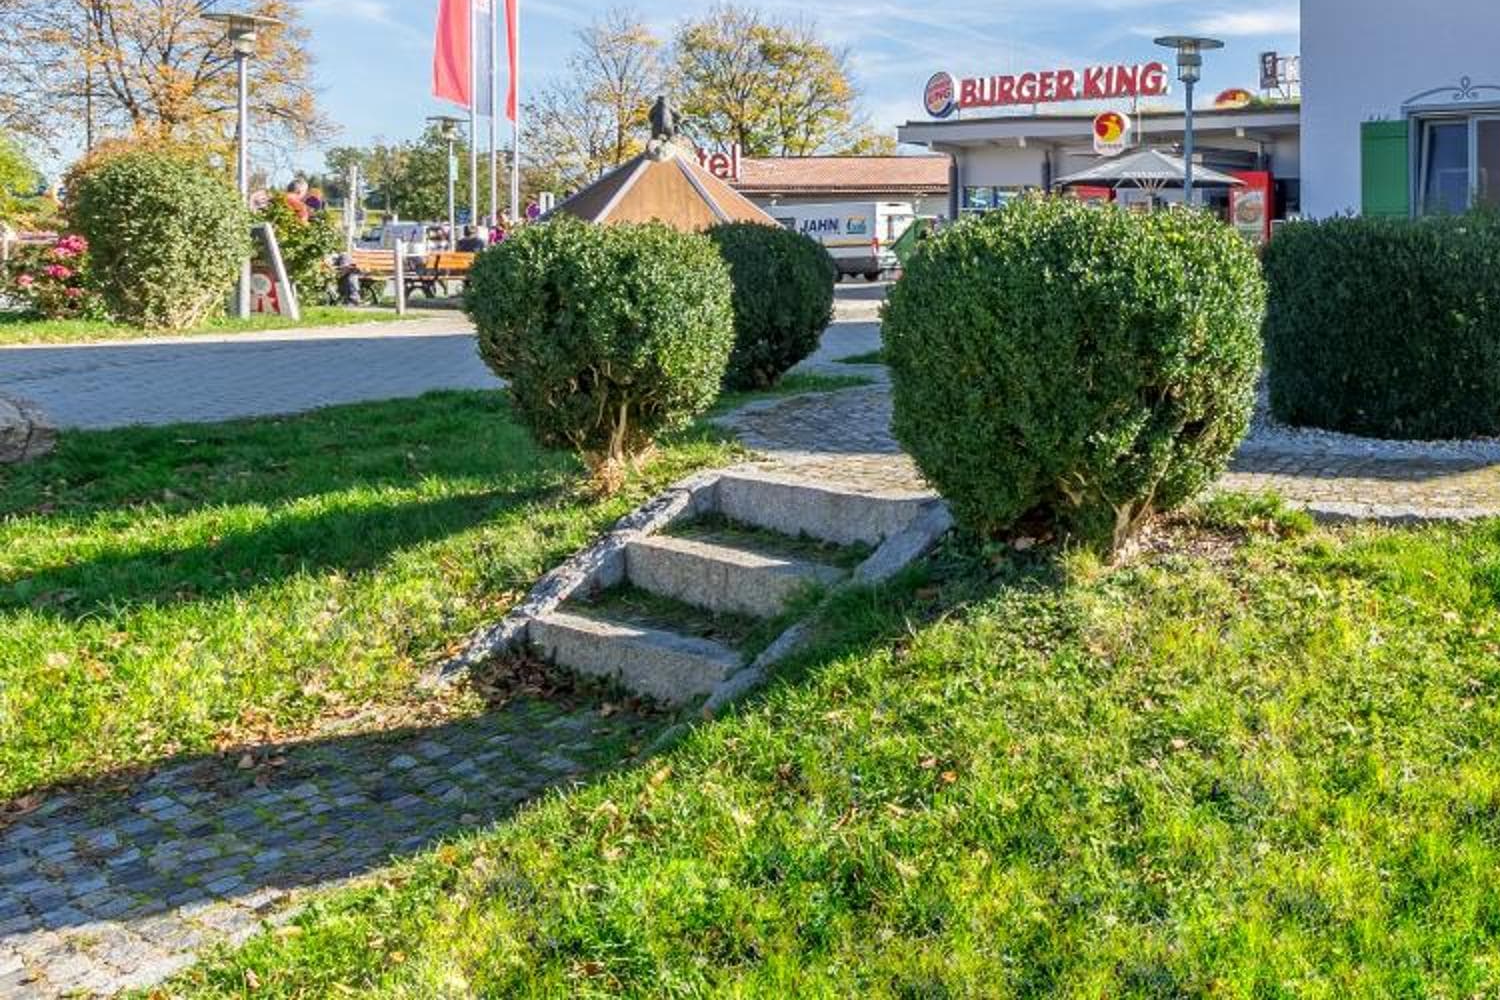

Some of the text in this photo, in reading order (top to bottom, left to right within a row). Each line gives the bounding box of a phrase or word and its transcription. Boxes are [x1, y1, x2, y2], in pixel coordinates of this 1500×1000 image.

[959, 61, 1165, 109] BURGER KING
[697, 143, 739, 182] tel
[800, 217, 840, 234] JAHN
